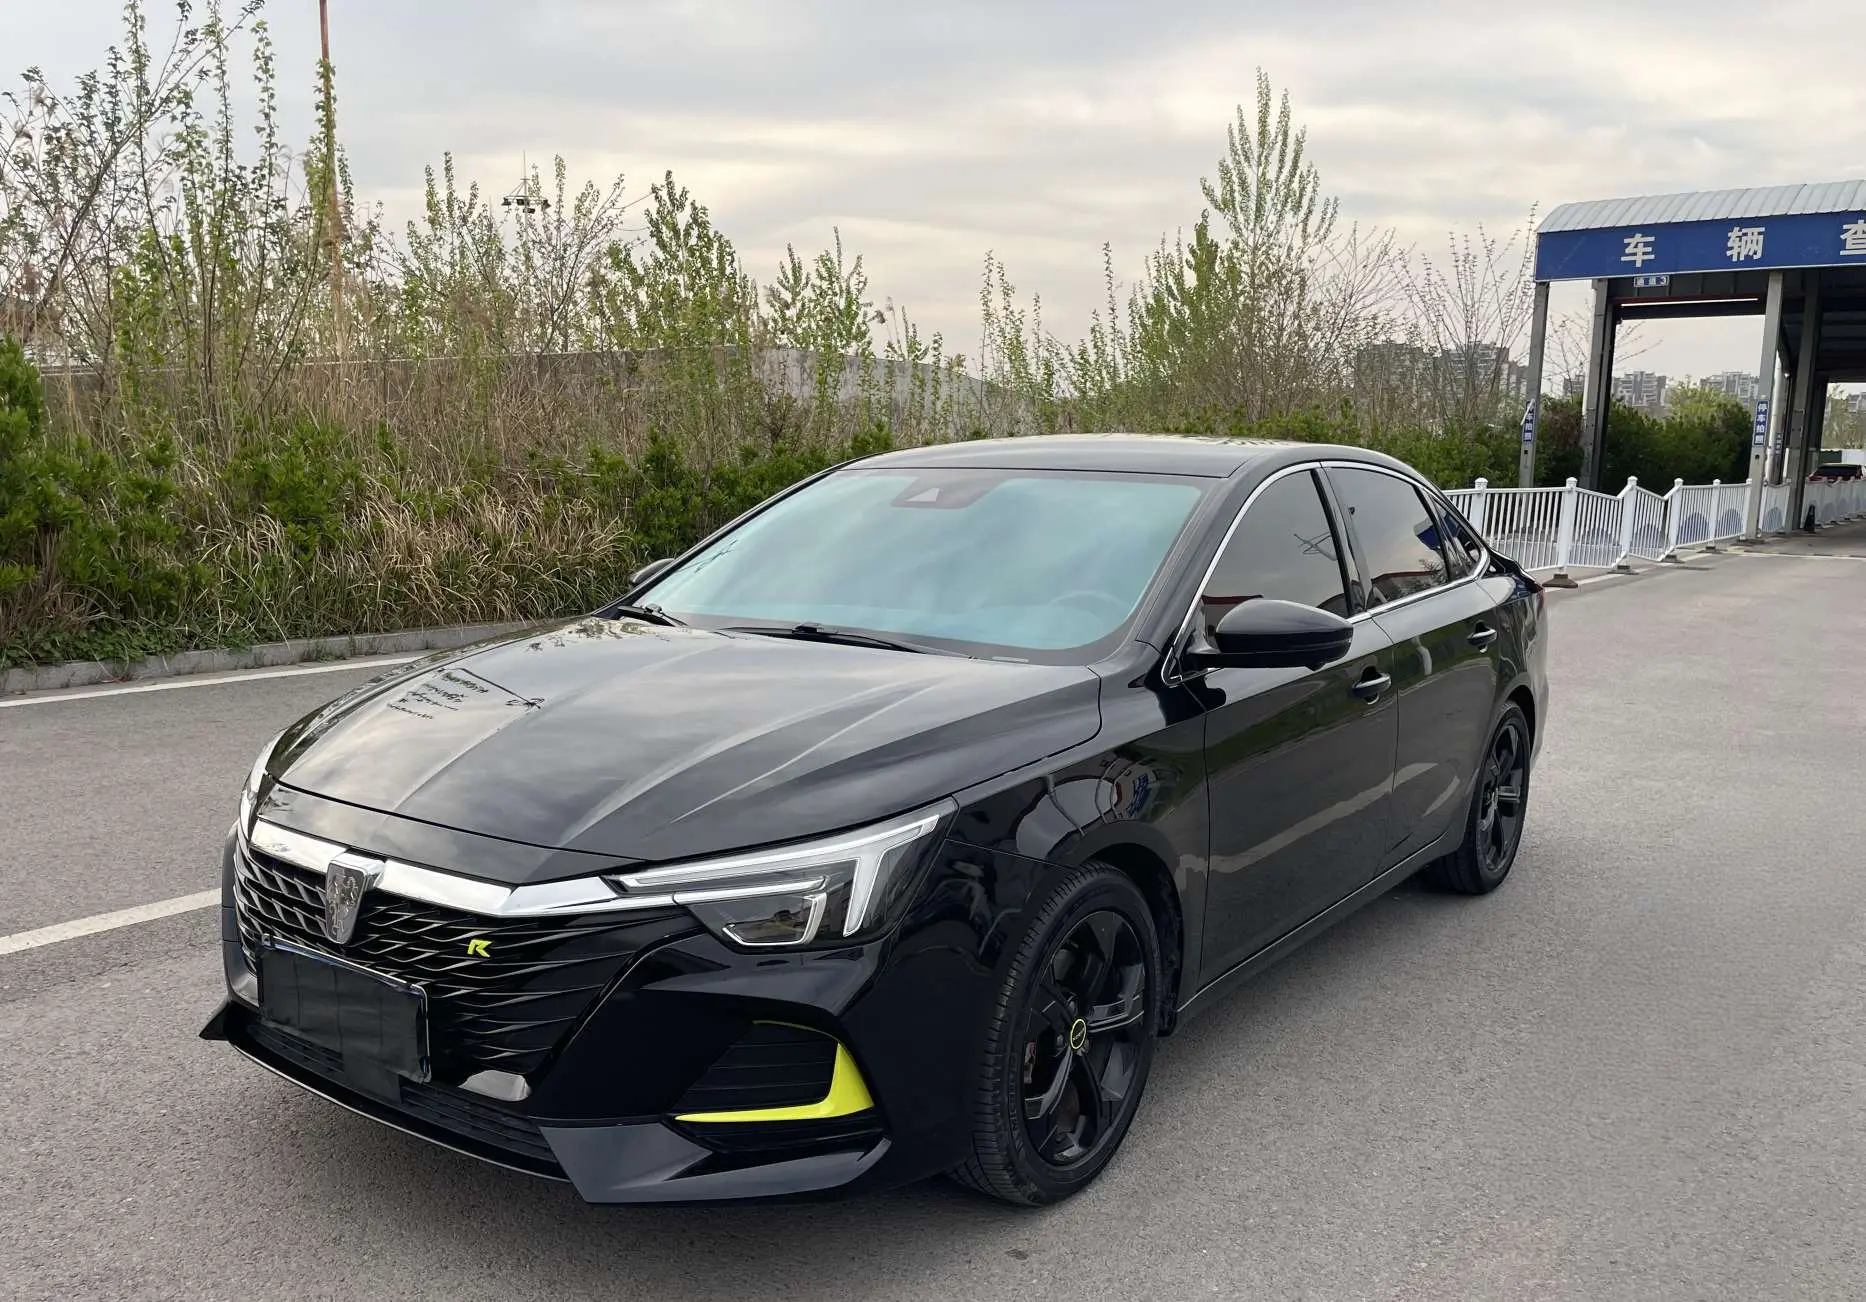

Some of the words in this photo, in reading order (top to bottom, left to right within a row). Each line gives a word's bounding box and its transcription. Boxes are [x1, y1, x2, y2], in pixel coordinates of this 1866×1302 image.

[1620, 219, 1866, 267] 车辆查
[467, 939, 494, 958] R
